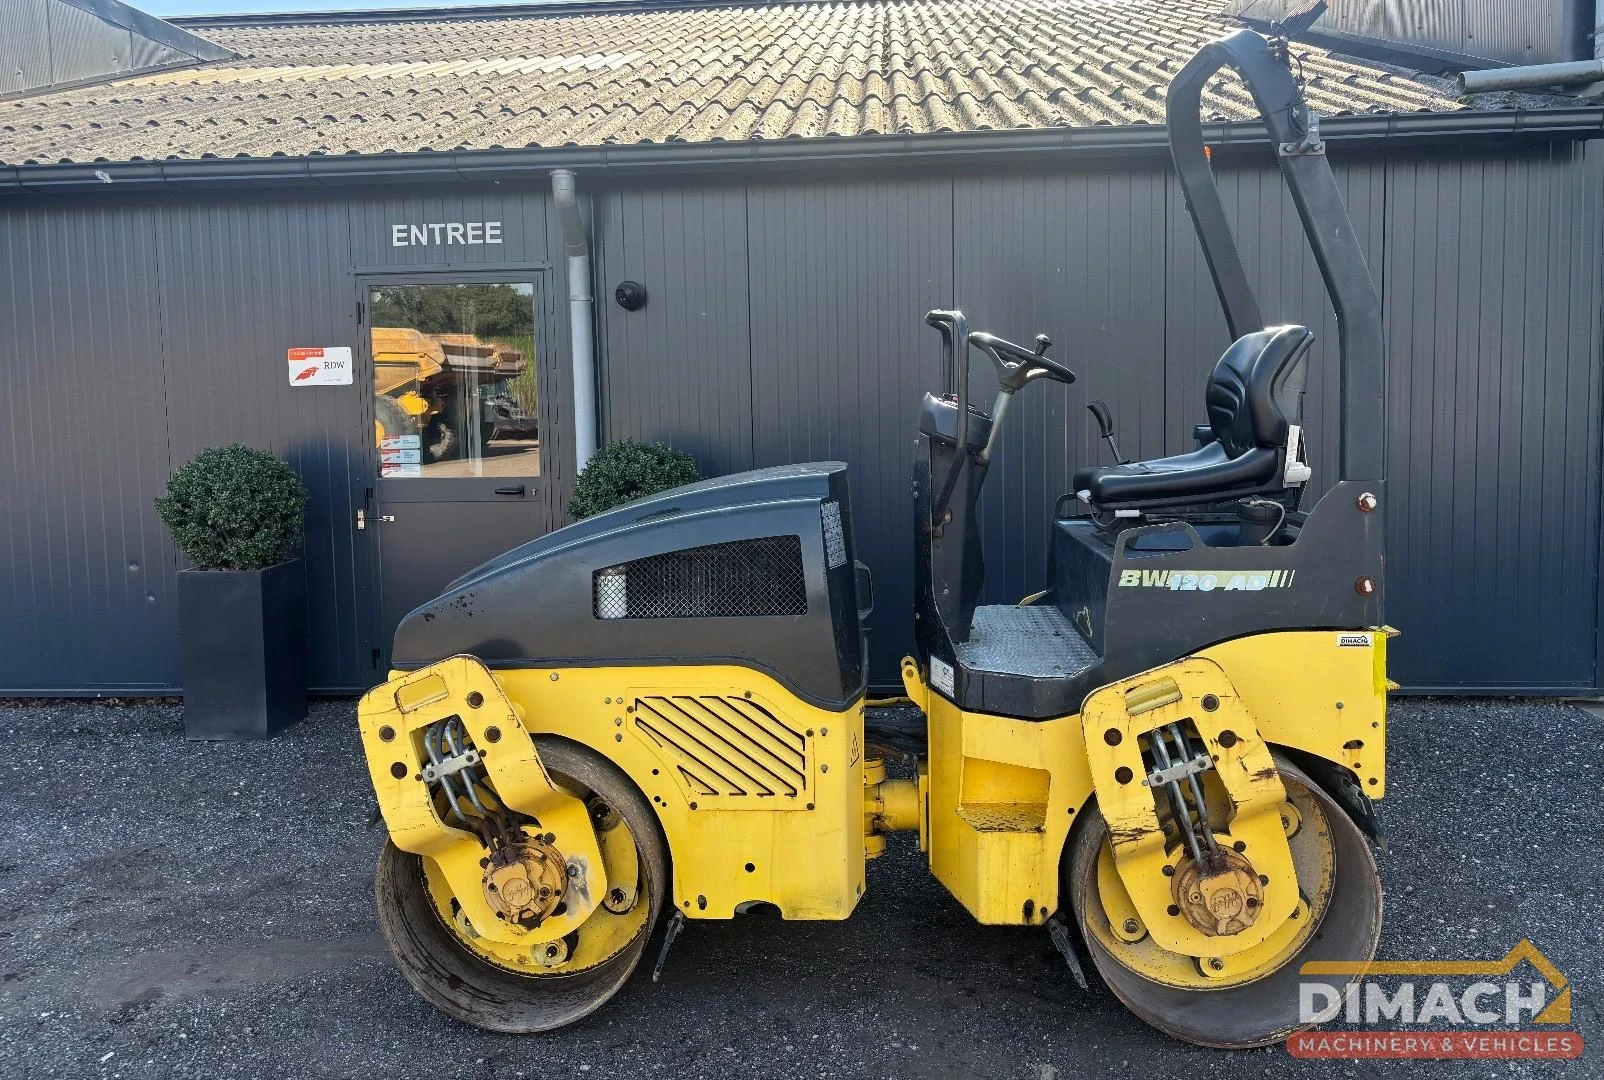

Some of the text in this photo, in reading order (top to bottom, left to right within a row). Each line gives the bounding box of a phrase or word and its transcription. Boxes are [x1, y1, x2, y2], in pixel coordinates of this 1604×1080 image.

[392, 222, 503, 246] ENTREE
[323, 361, 345, 370] RDW
[1169, 574, 1218, 592] 120
[1223, 574, 1268, 591] AD
